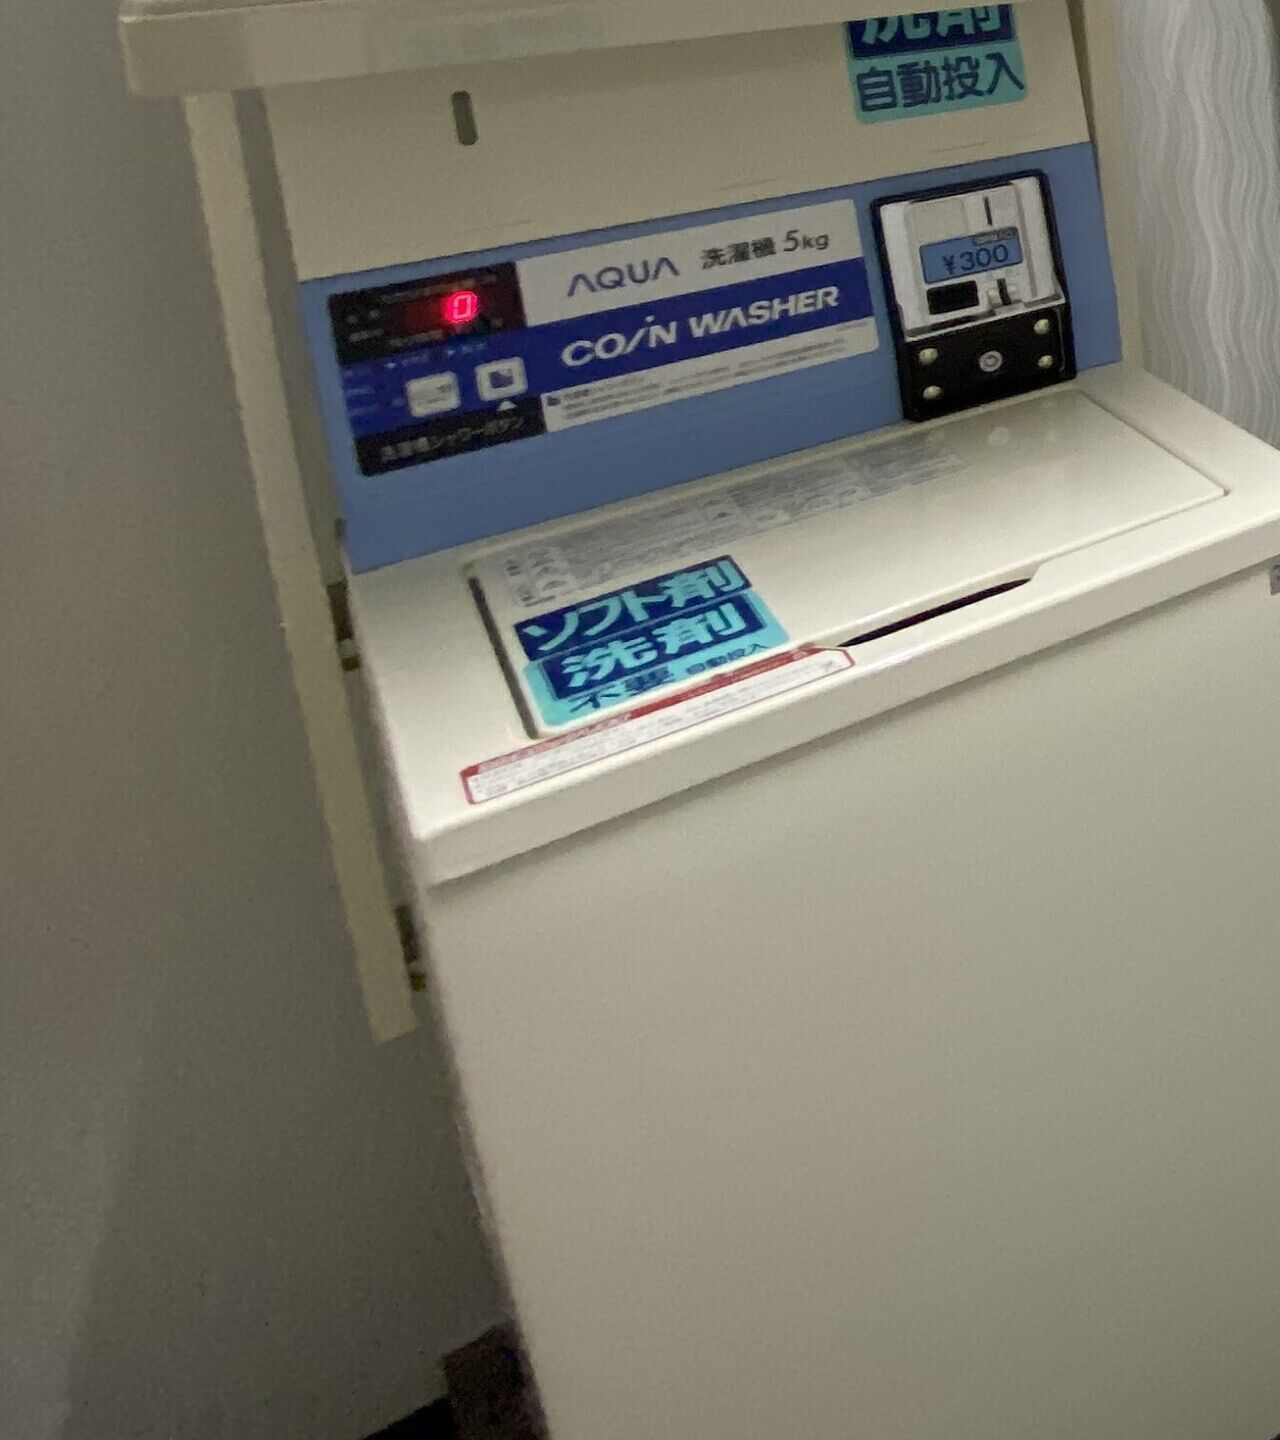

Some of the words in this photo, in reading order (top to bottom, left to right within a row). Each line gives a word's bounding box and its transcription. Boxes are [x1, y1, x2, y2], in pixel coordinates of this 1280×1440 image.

[856, 51, 1025, 112] 自動投入
[567, 256, 680, 297] AQUA
[701, 237, 777, 270] 洗濯機
[943, 244, 1009, 275] ¥300
[452, 294, 473, 320] 0
[688, 285, 841, 339] WASHER
[522, 559, 745, 651] ソフト剤
[561, 602, 746, 688] 洗剤
[570, 664, 676, 713] 不要
